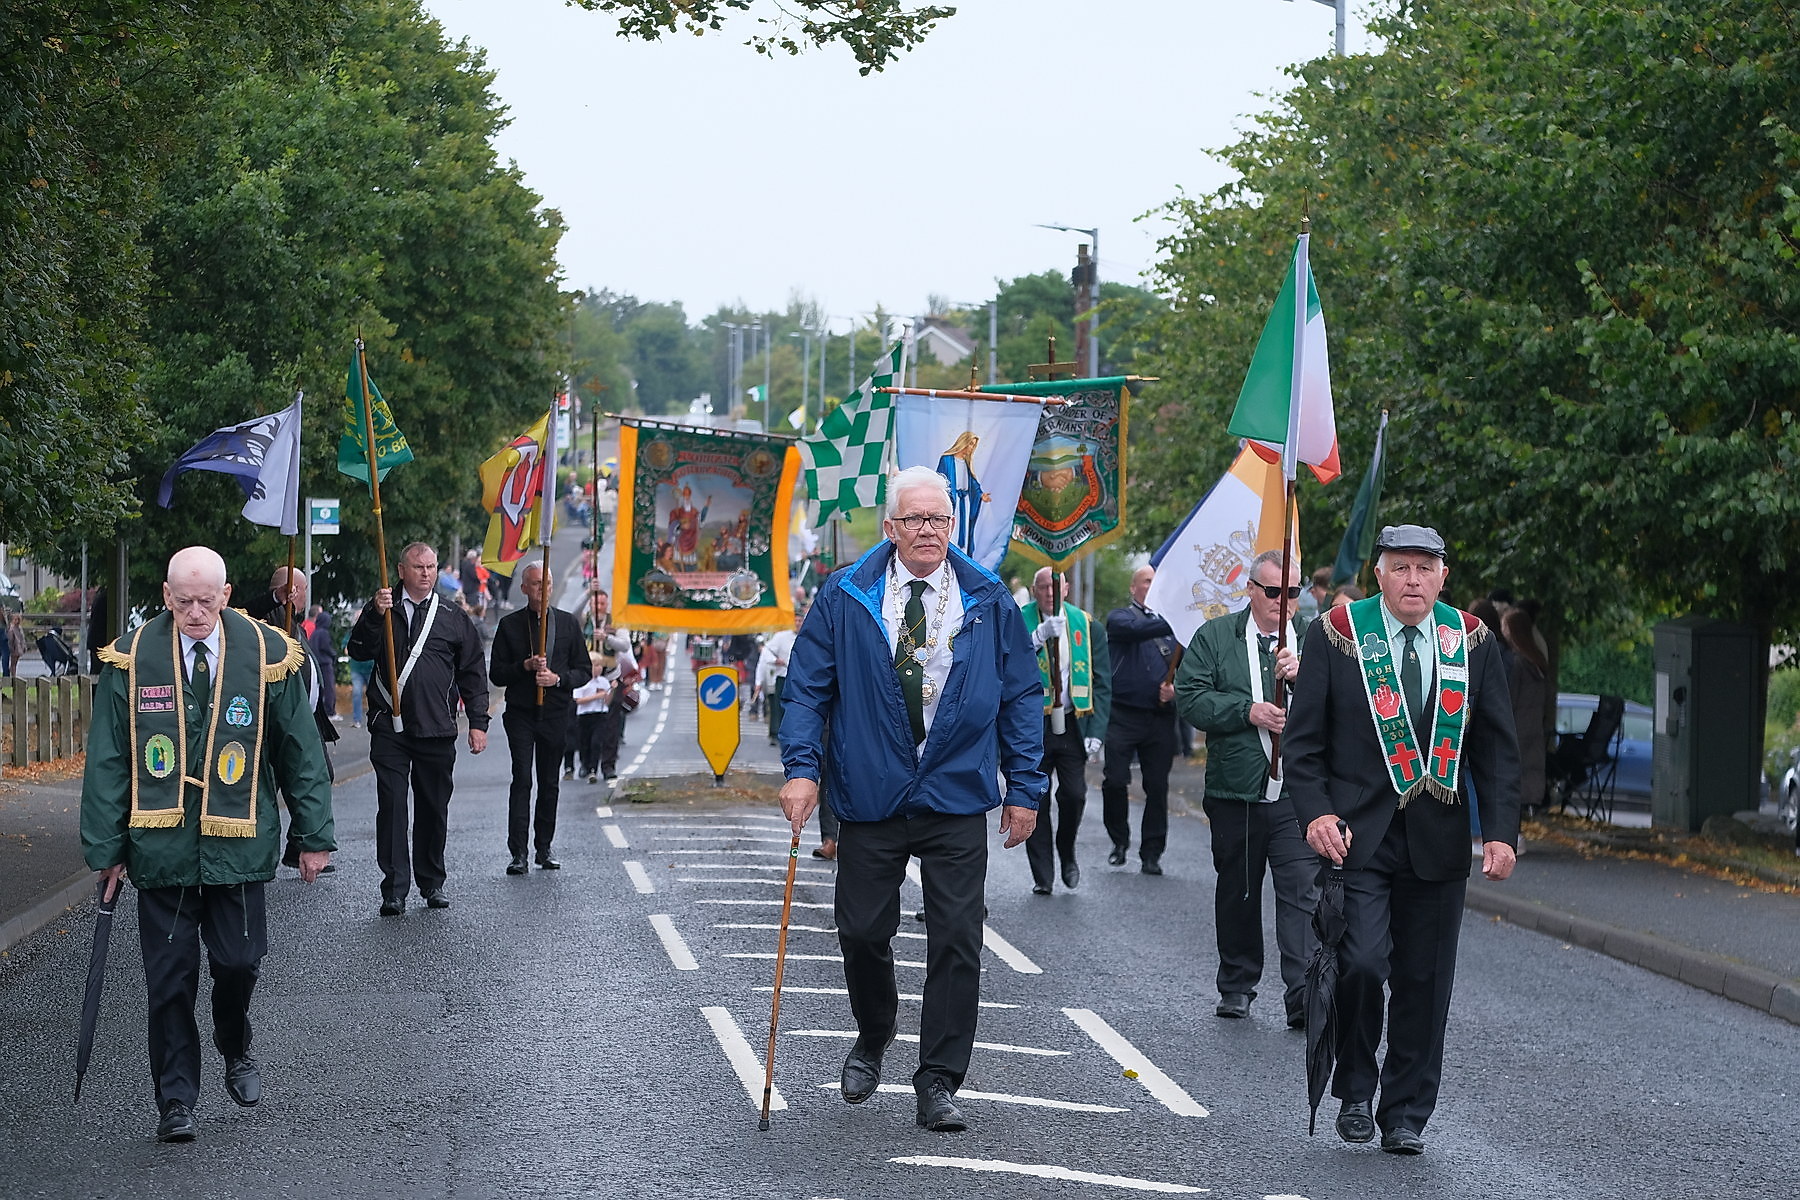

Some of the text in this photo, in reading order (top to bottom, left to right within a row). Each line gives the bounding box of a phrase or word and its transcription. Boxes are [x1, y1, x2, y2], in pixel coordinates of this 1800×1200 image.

[1058, 405, 1087, 418] ORDER
[1092, 410, 1107, 419] OF
[1039, 420, 1083, 436] BERNIANS
[1026, 524, 1091, 551] BOARD OF ERIN
[1367, 664, 1393, 678] AOH
[1381, 718, 1405, 732] DIV
[1389, 729, 1405, 741] 30
